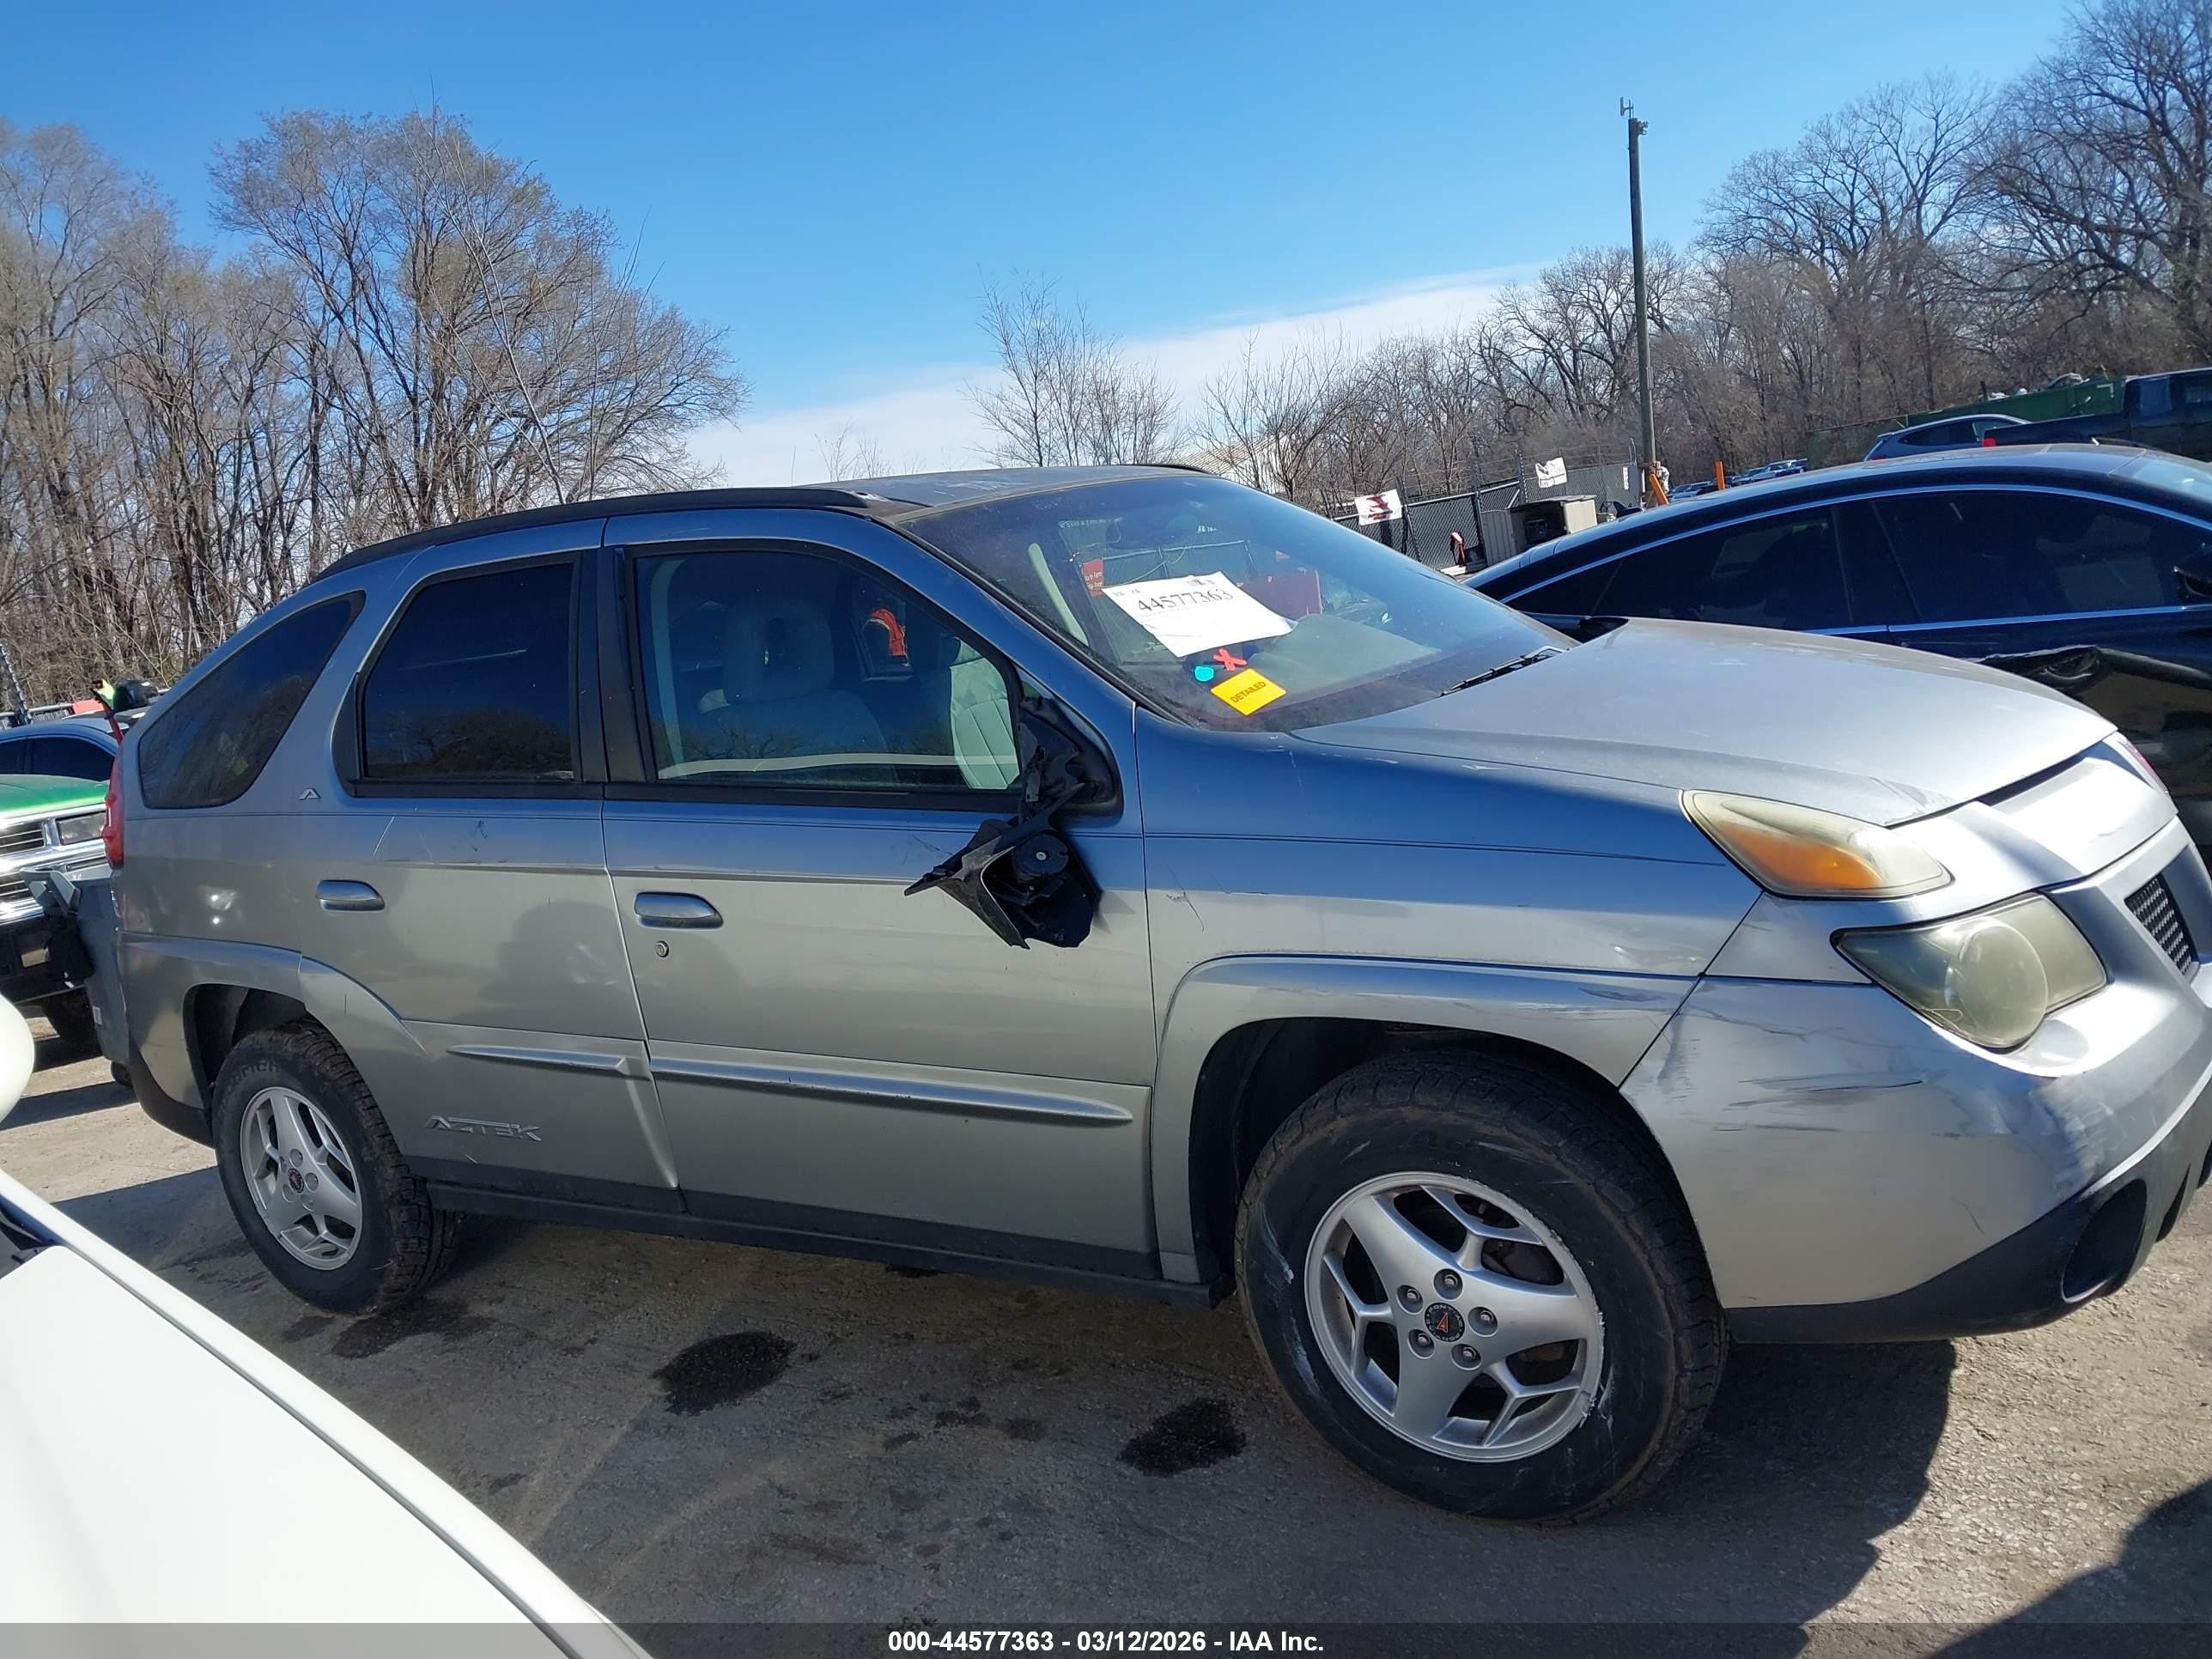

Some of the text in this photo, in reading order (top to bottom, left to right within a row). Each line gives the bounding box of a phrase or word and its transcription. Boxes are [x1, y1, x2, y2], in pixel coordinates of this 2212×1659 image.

[1138, 588, 1234, 611] 44577363
[1230, 681, 1267, 703] DETAILED
[424, 1115, 543, 1142] AZTEK
